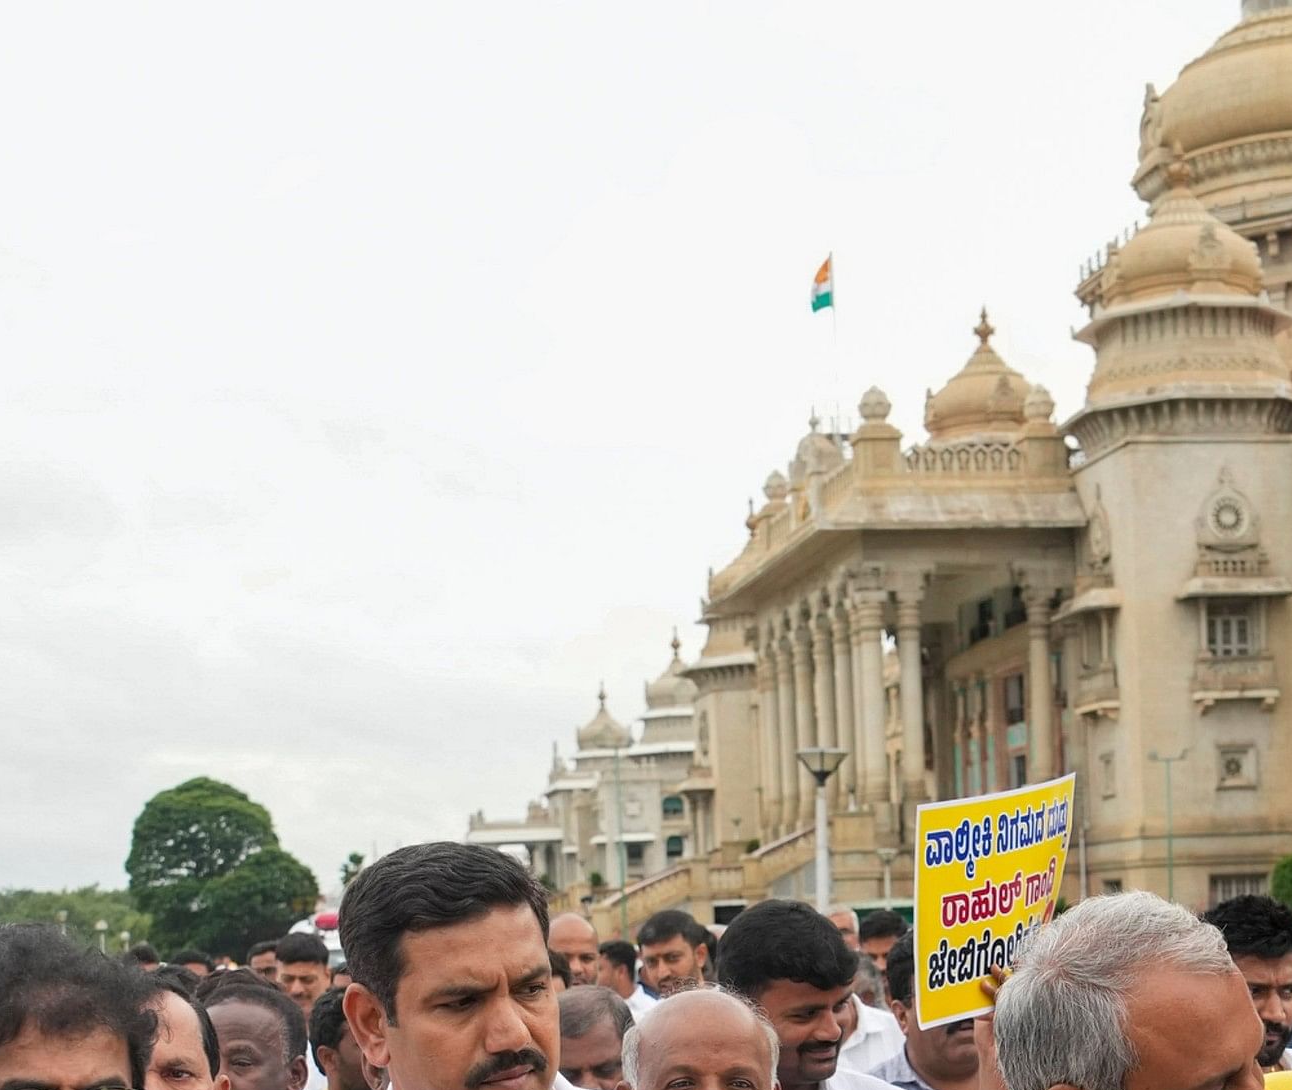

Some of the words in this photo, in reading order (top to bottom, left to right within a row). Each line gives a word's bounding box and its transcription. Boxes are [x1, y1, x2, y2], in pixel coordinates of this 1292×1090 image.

[925, 816, 992, 878] ವಾಲ್ಮೀಕಿ
[996, 802, 1045, 854] ನಿಗಮದ
[942, 871, 1022, 927] ರಾಹುಲ್
